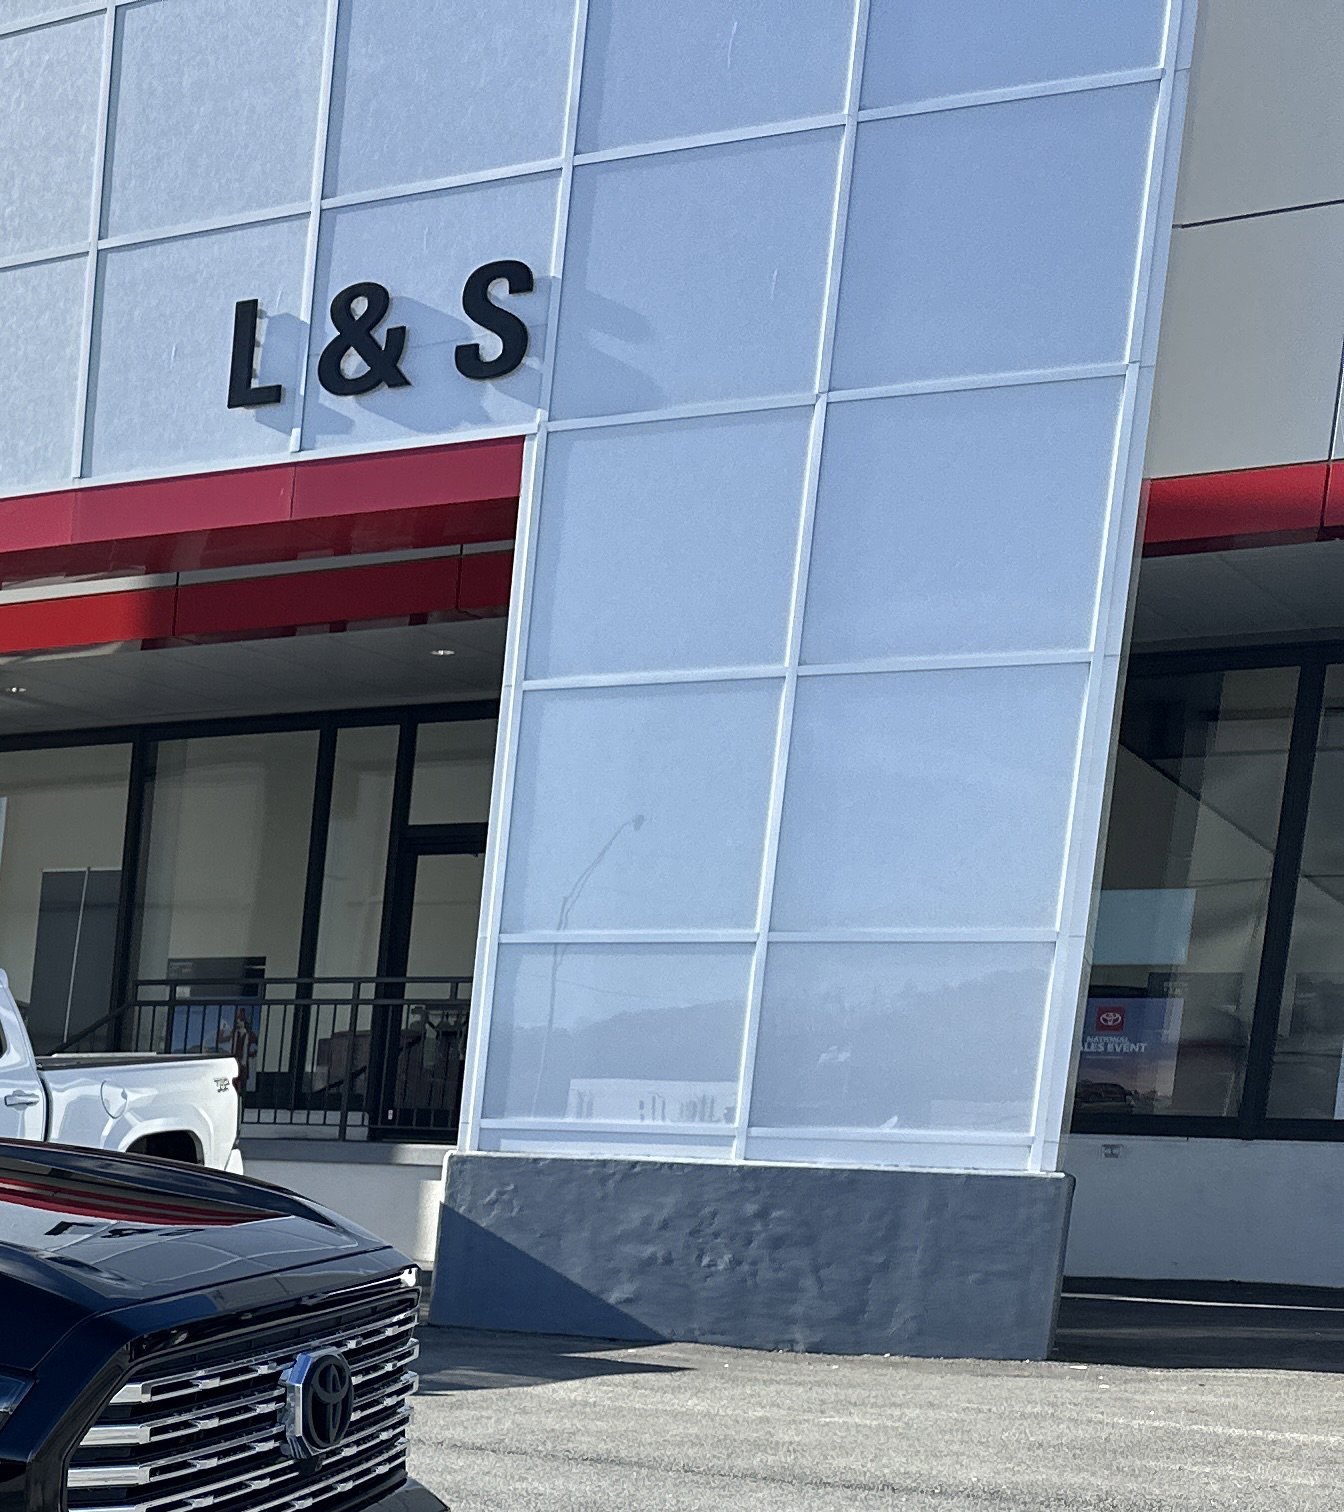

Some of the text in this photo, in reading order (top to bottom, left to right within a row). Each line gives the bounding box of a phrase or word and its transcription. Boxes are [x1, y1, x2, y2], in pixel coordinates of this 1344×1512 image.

[227, 259, 534, 409] L & S
[1086, 1035, 1128, 1043] NATIONAL
[1107, 1042, 1147, 1053] EVENT
